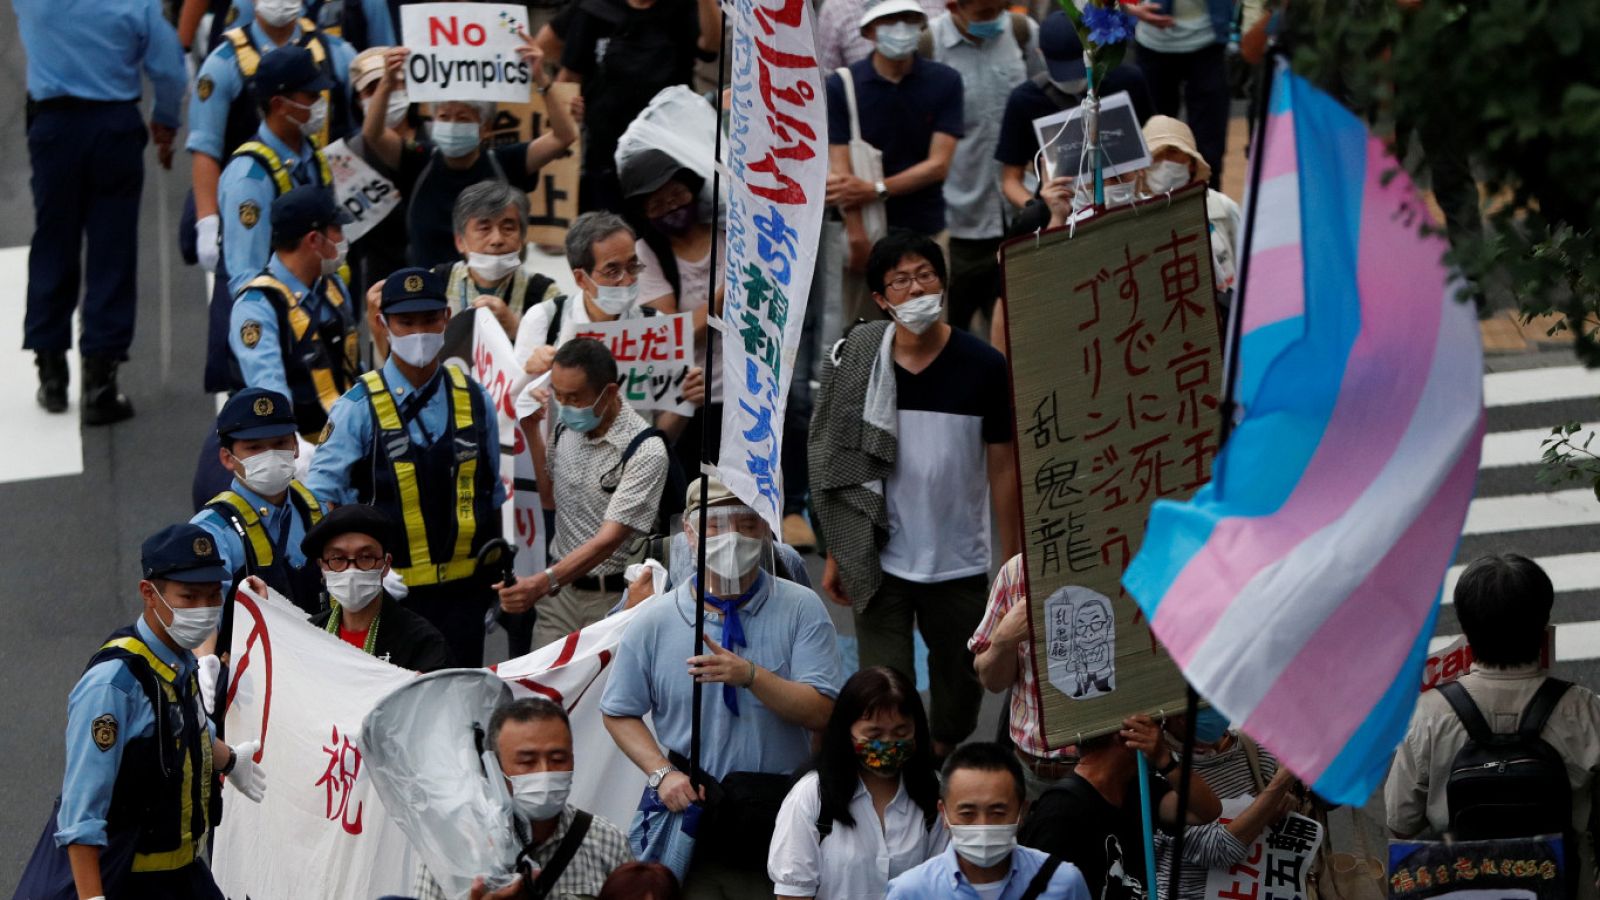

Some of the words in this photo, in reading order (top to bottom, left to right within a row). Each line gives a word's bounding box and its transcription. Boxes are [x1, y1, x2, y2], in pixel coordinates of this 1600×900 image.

[428, 16, 487, 47] No
[409, 53, 529, 88] Olympics
[337, 179, 391, 222] pics
[576, 316, 684, 362] 止だ!
[616, 364, 690, 406] ピッ
[1112, 243, 1178, 506] すでに死
[1073, 268, 1143, 624] ゴリンジュウ
